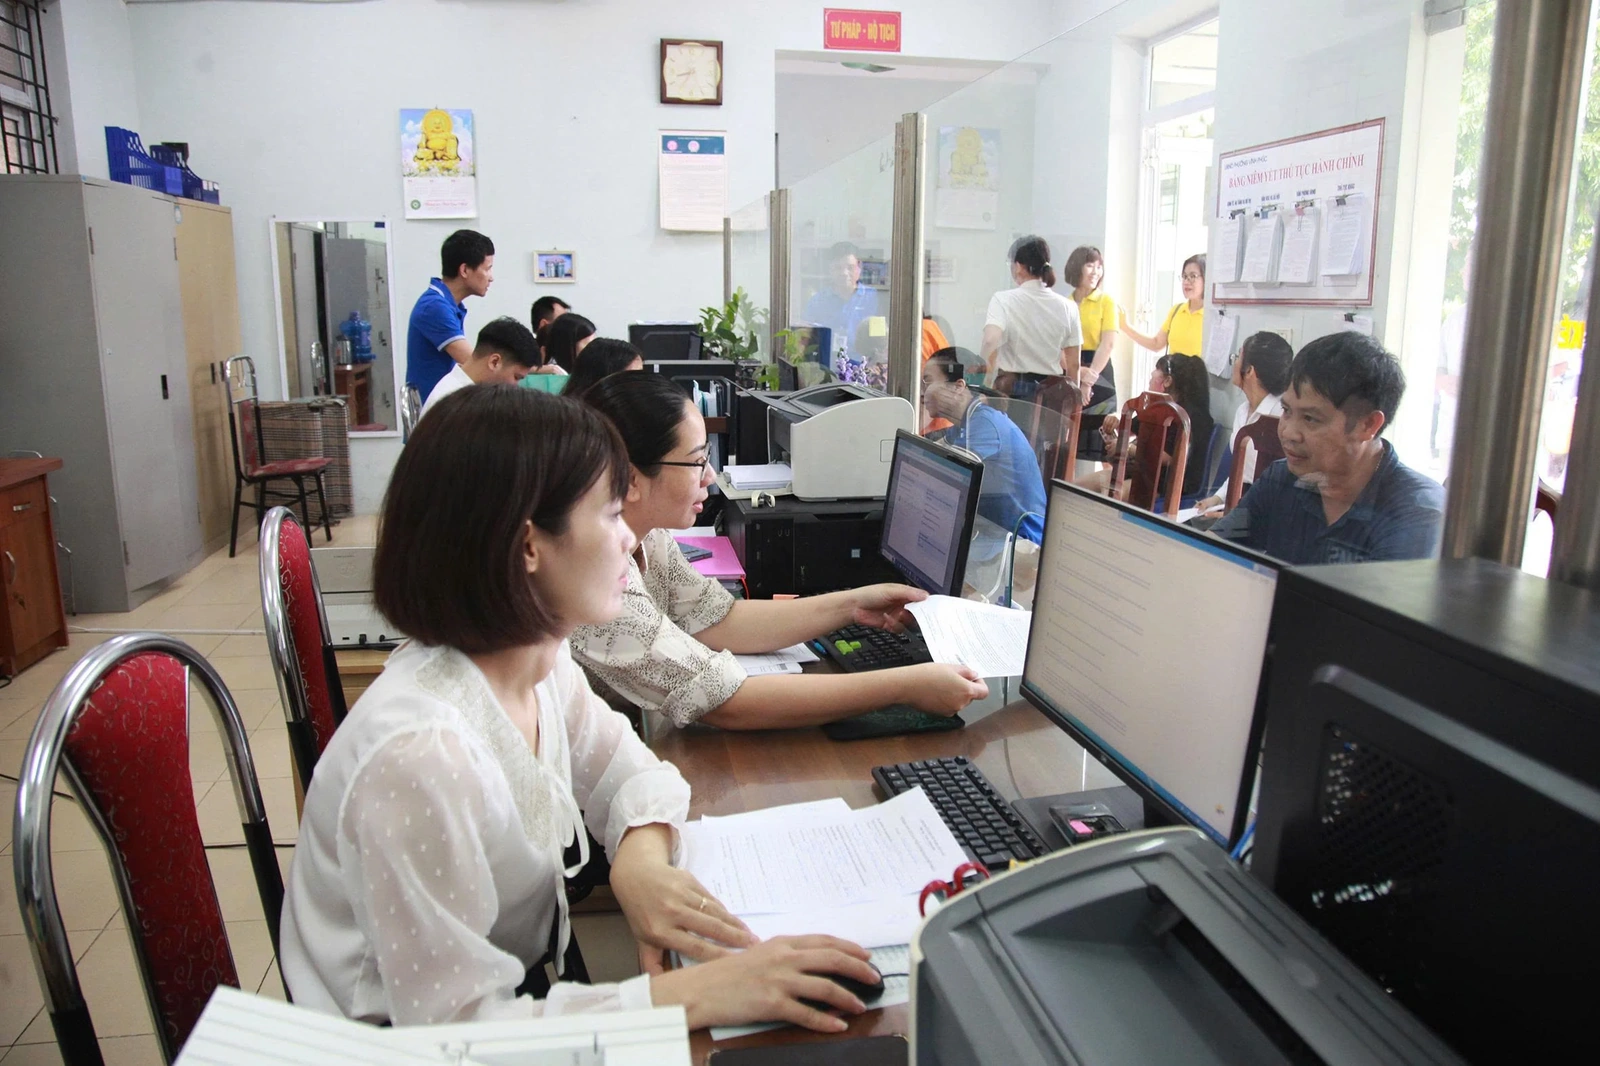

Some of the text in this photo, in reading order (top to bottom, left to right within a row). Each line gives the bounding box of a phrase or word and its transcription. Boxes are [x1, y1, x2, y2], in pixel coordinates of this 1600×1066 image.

[841, 19, 861, 39] PHÁP
[879, 23, 896, 43] TỊCH
[1228, 175, 1245, 188] BẢNG
[1278, 164, 1294, 180] THỦ
[1295, 163, 1310, 179] TỤC
[1311, 158, 1335, 174] HÀNH
[1336, 153, 1364, 170] CHÍNH
